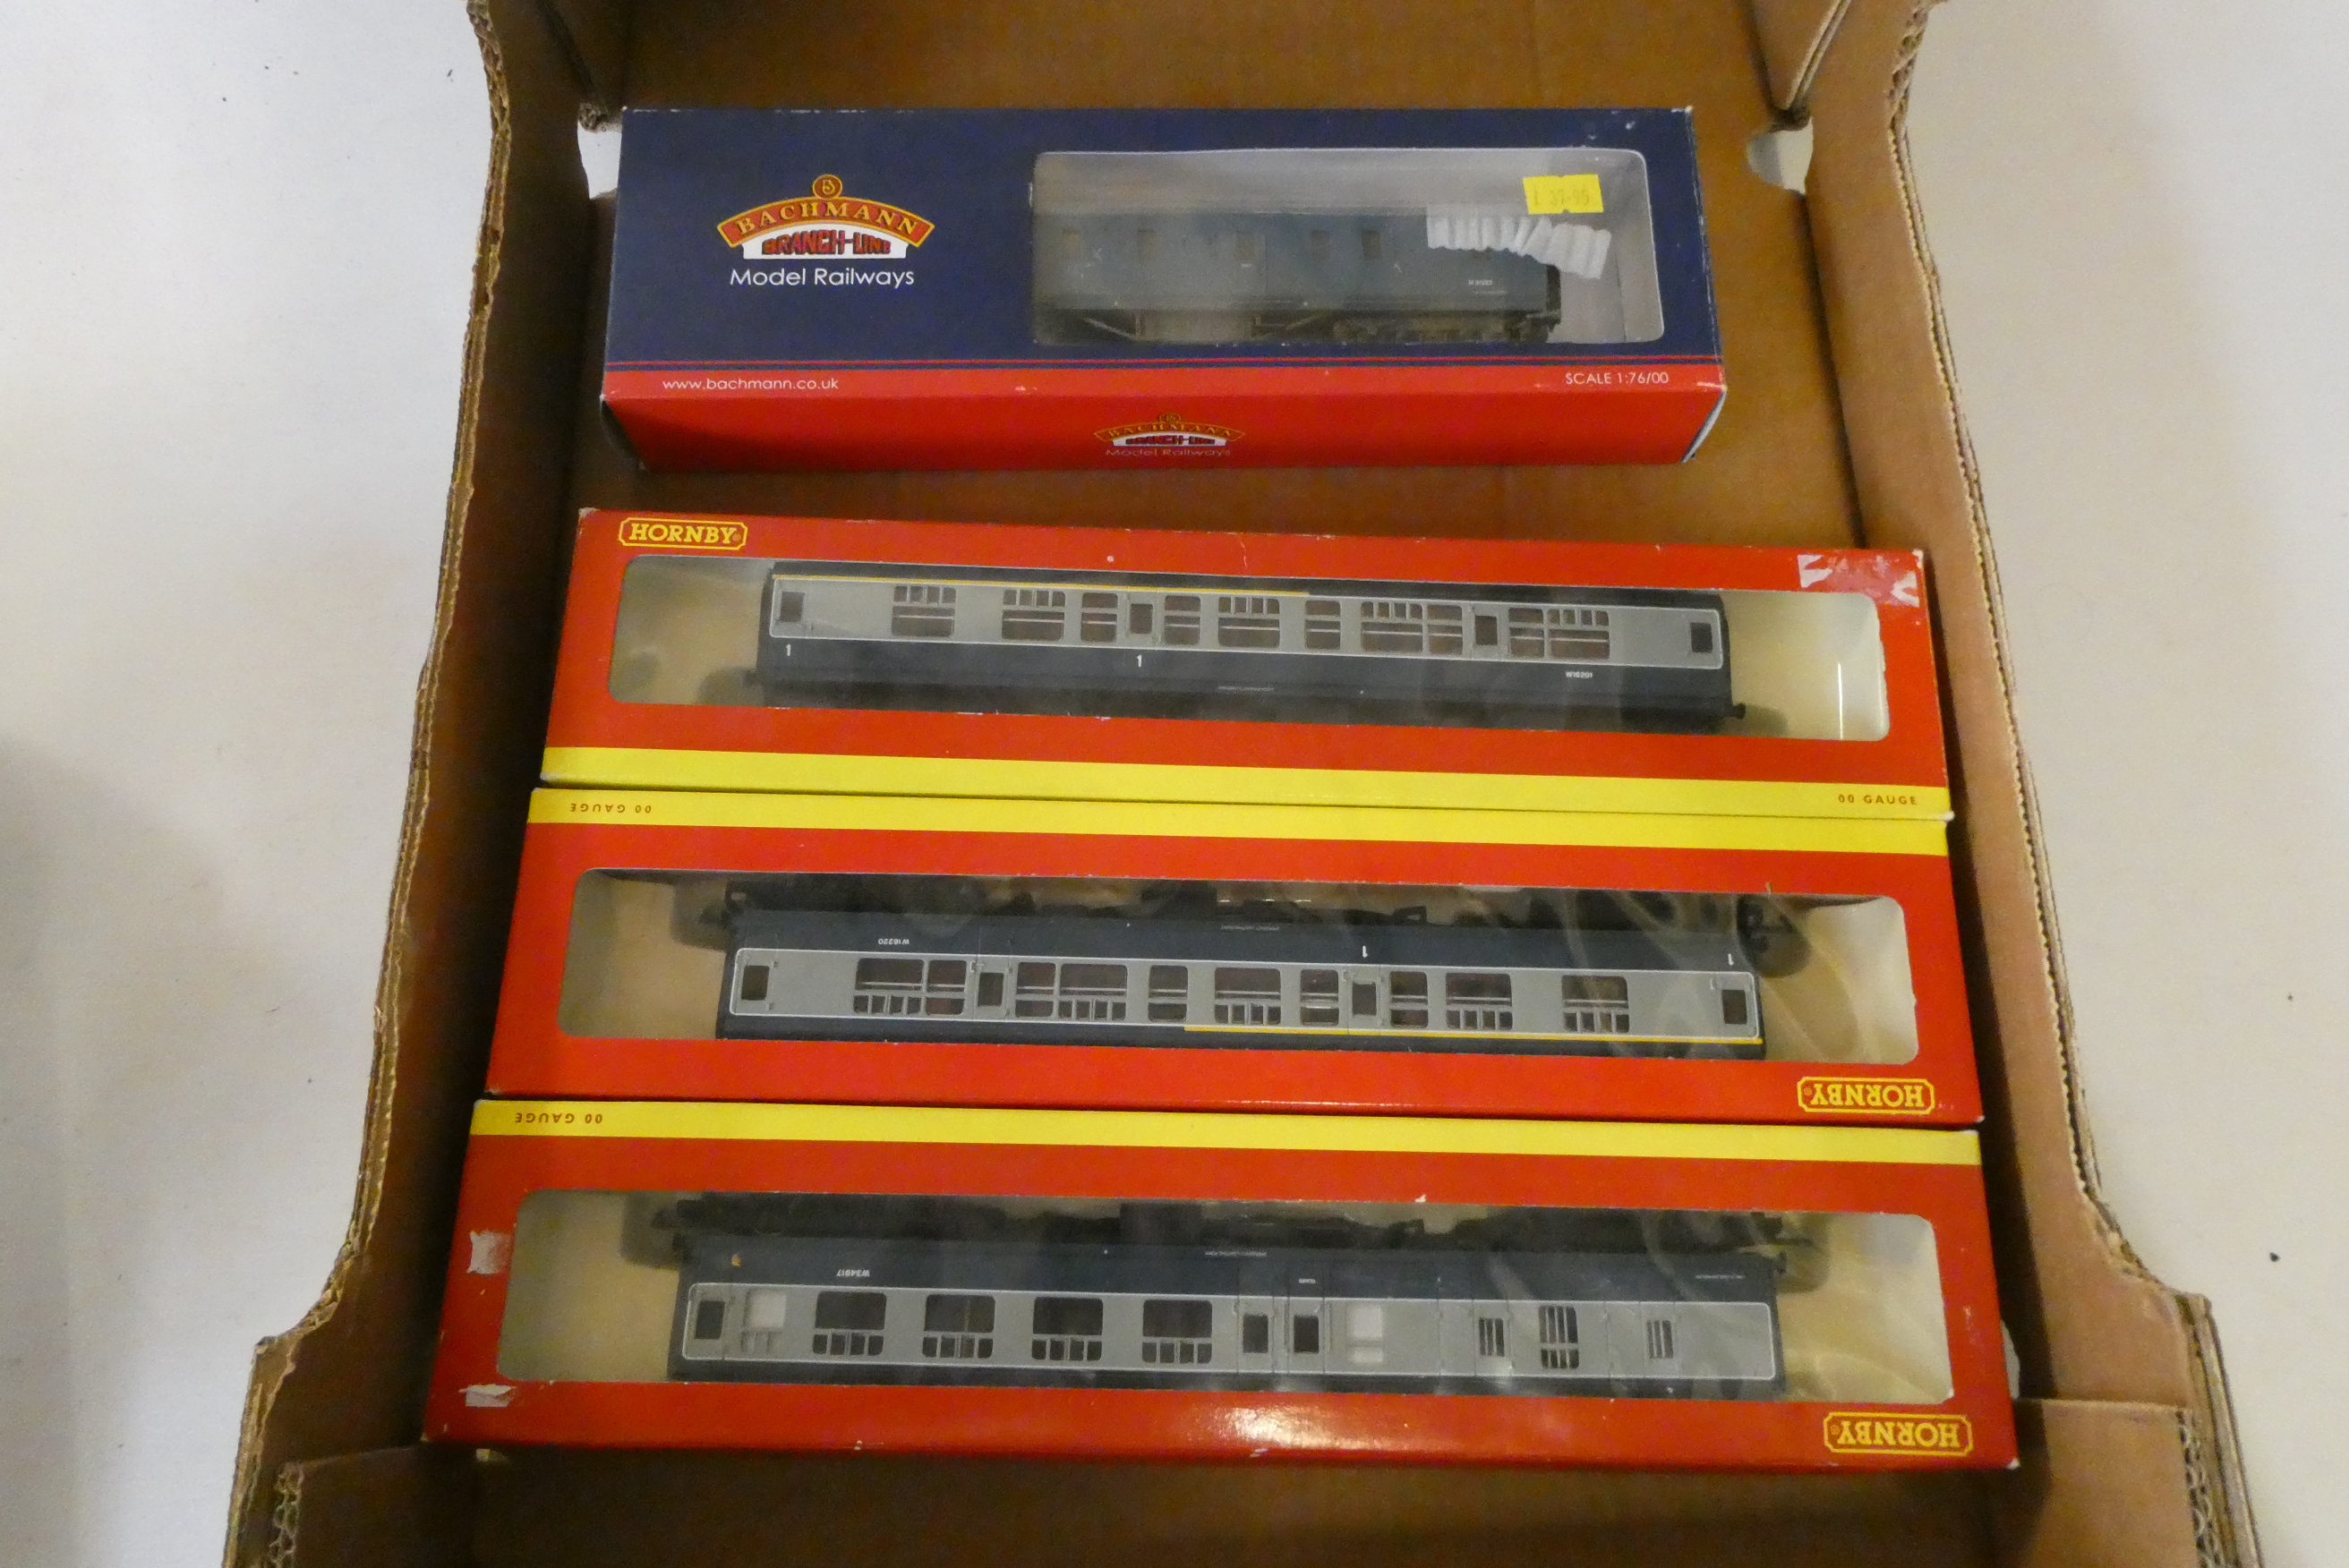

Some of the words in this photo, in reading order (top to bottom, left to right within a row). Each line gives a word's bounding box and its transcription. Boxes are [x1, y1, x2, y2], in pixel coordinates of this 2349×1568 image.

[735, 202, 918, 235] BACHMANN
[761, 229, 892, 256] BRANCH-LINE
[730, 268, 806, 286] Model
[814, 268, 915, 289] Railways
[662, 378, 840, 390] www.bachmann.co.uk
[1565, 372, 1611, 385] SCALE
[1163, 448, 1231, 457] Railways
[628, 523, 738, 544] HORNBY
[785, 643, 791, 657] 1
[1136, 654, 1142, 668] 1
[1863, 794, 1918, 805] GAUGE
[569, 803, 626, 814] GAUGE
[1362, 945, 1369, 958] 1
[1727, 952, 1735, 967] 1
[1809, 1083, 1925, 1107] HORNBY
[515, 1112, 576, 1123] GAUGE
[1837, 1420, 1960, 1447] HORNBY
